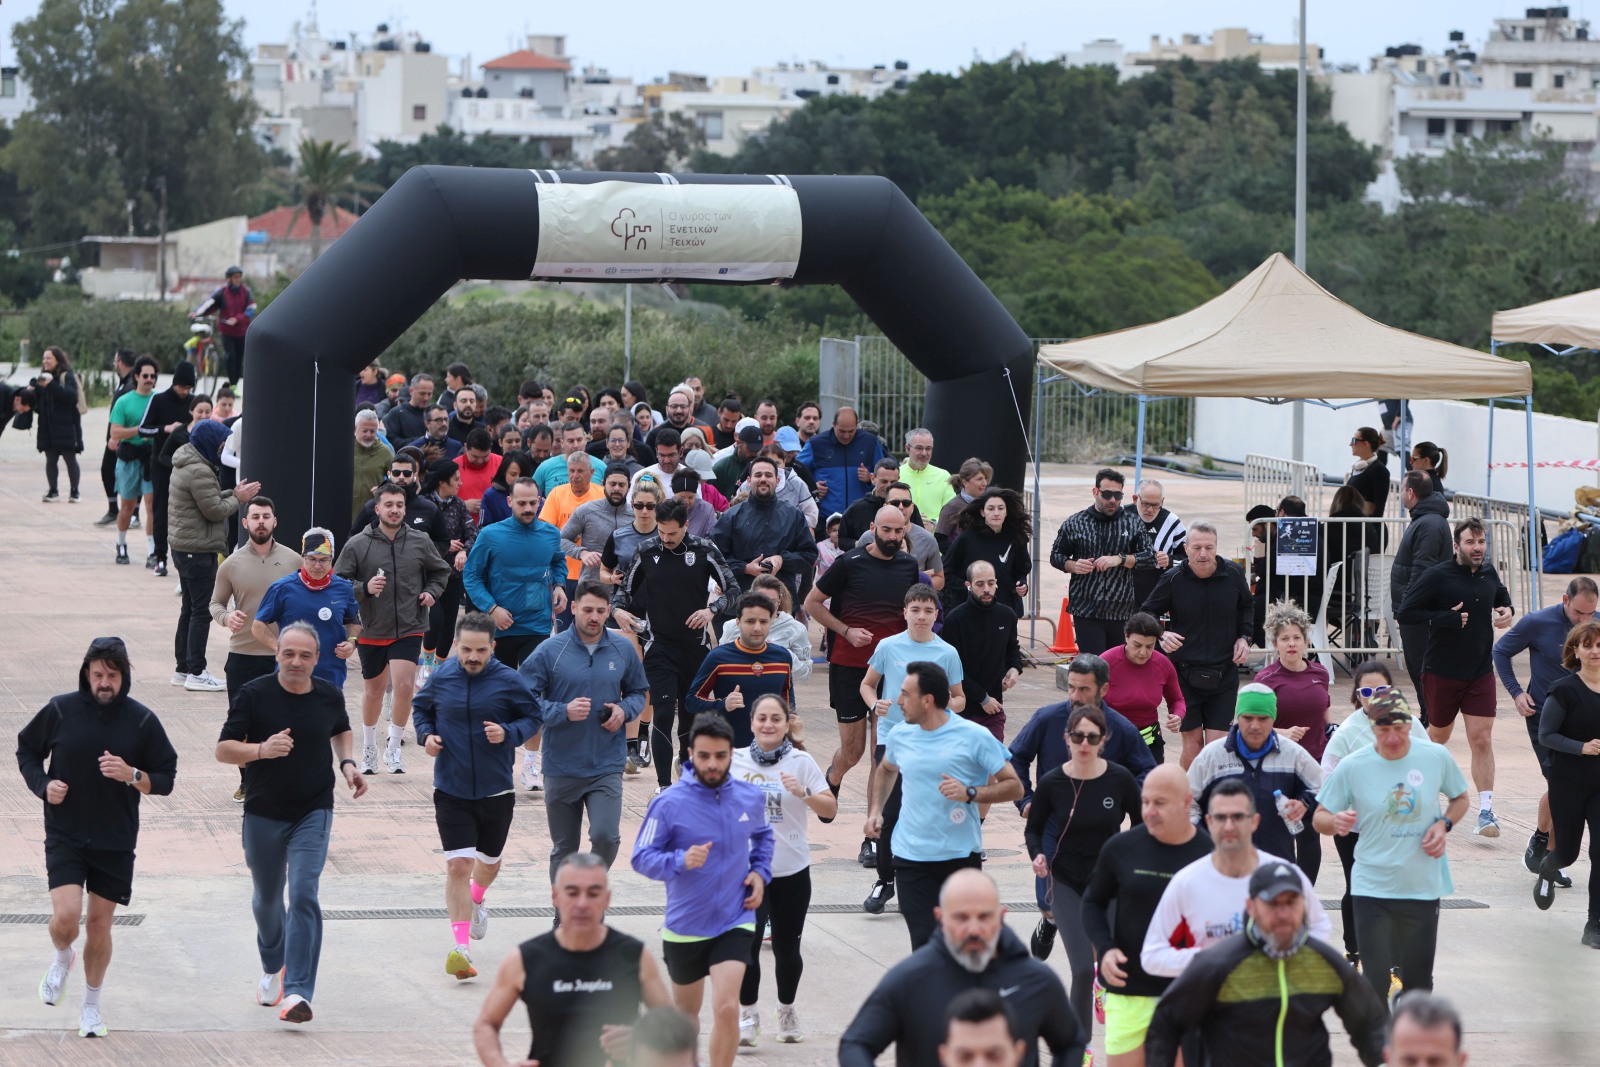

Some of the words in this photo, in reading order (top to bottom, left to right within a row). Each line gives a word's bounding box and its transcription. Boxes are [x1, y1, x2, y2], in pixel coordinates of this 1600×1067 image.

[680, 211, 710, 223] γύρος
[714, 213, 732, 221] των
[669, 224, 719, 234] Ενετικών
[669, 237, 706, 246] Τειχών
